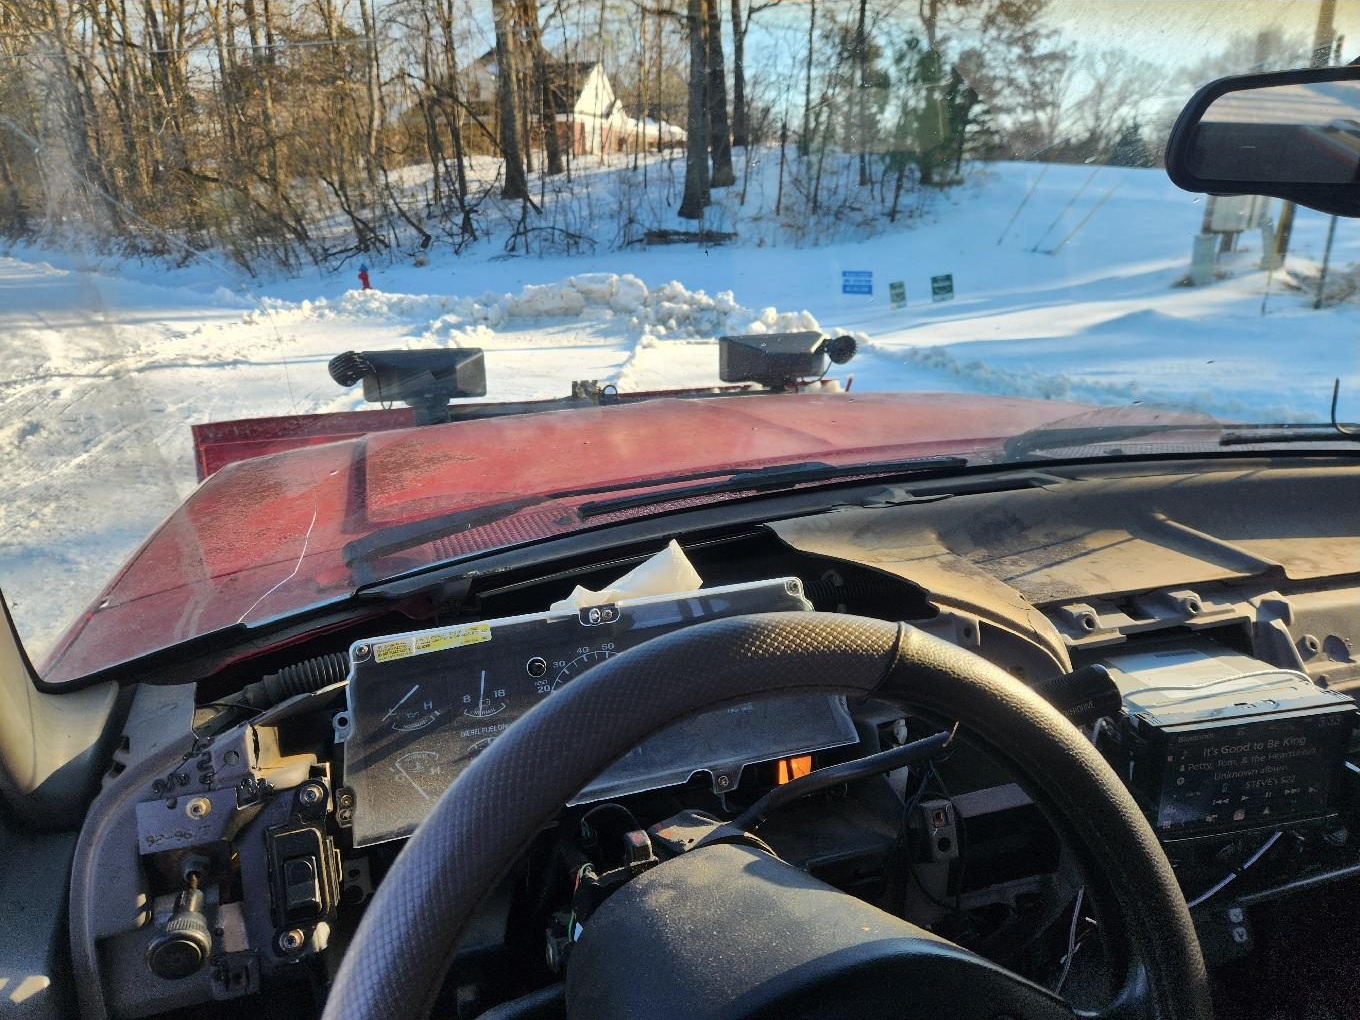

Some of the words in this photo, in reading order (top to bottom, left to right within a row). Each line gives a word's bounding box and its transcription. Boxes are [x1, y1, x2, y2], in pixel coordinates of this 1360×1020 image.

[576, 646, 590, 654] 40
[602, 642, 614, 650] 50
[553, 660, 566, 668] 30
[537, 684, 550, 694] 20
[494, 690, 506, 698] 18
[464, 694, 472, 703] 8
[424, 701, 432, 710] H
[482, 726, 498, 734] FUEL
[1204, 746, 1218, 757] It's
[1221, 742, 1251, 754] Good
[1254, 741, 1264, 750] to
[1268, 739, 1280, 749] Be
[1283, 736, 1307, 747] King
[1214, 768, 1258, 781] Unknown
[1260, 764, 1288, 775] album
